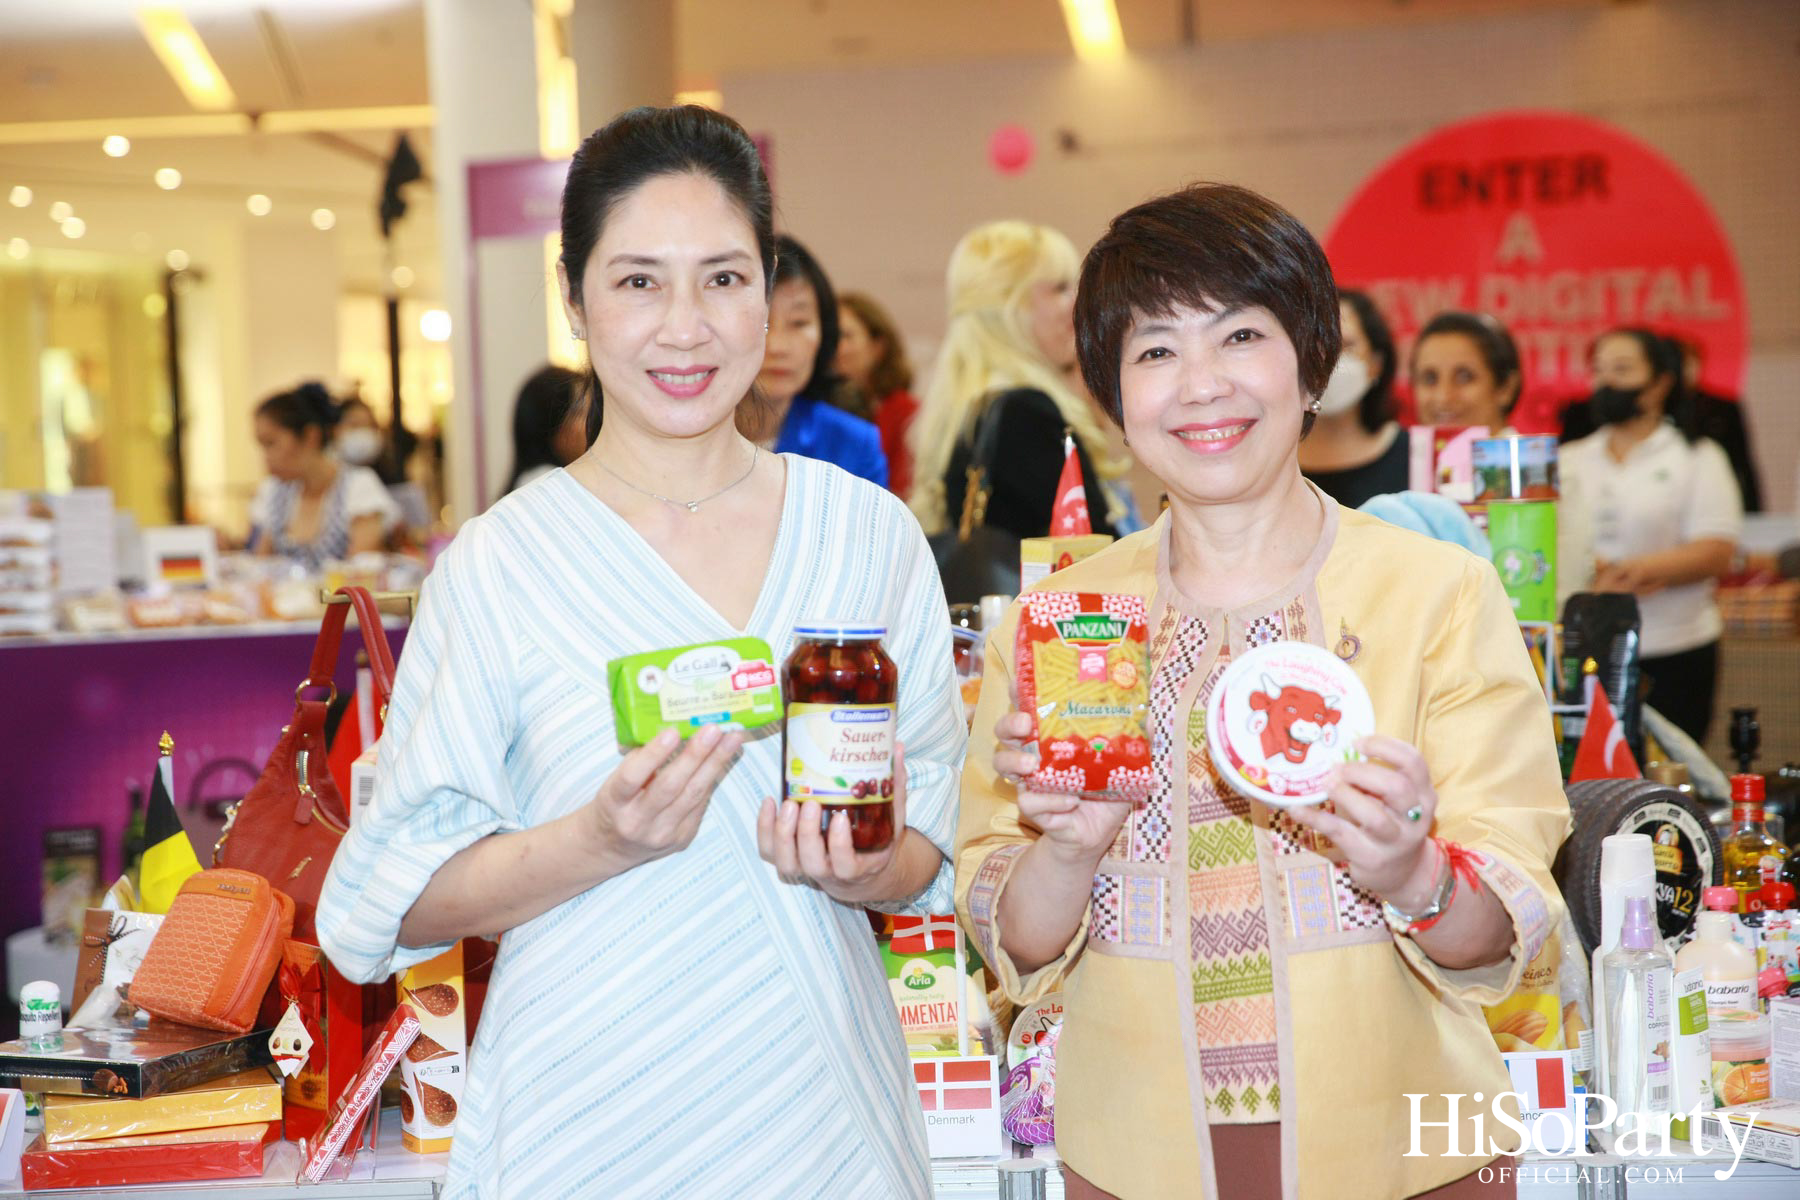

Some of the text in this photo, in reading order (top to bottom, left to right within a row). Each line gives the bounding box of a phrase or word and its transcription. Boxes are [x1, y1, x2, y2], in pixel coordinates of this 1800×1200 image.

[1418, 155, 1611, 209] ENTER
[1500, 213, 1543, 263] A
[1482, 266, 1730, 322] DIGITAL
[1062, 622, 1122, 638] PANZANI
[1059, 702, 1132, 717] Macaroni
[840, 728, 886, 743] Sauer-
[829, 747, 889, 763] kirschen
[1673, 886, 1695, 913] 12
[909, 974, 931, 986] Arla
[1646, 973, 1655, 1019] babaria
[1707, 985, 1749, 995] babaria
[1036, 1007, 1050, 1016] The
[927, 1114, 976, 1126] Denmark
